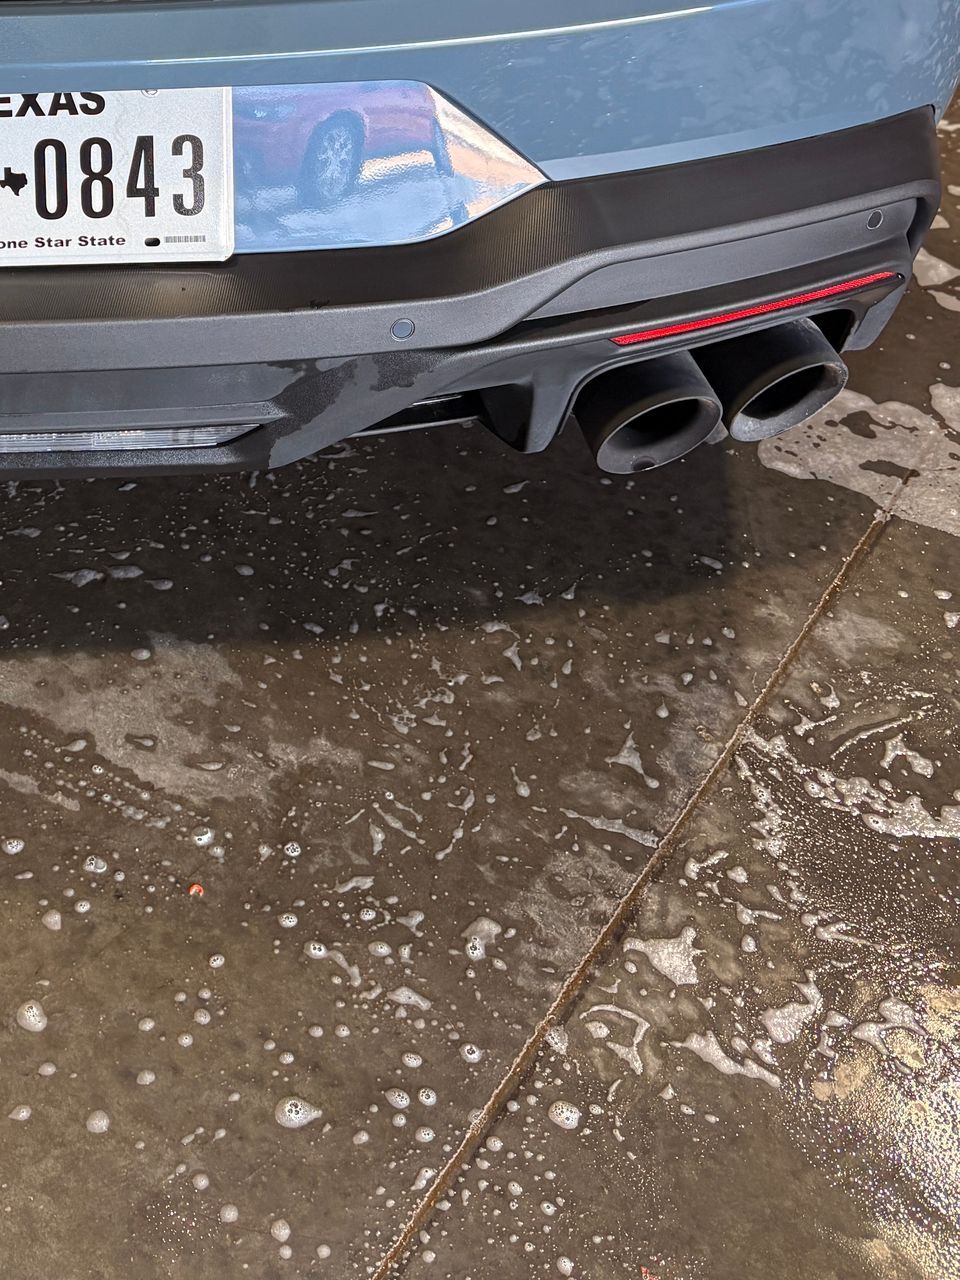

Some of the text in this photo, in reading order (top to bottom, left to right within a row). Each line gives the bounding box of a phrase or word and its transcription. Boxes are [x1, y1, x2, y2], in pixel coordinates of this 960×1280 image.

[34, 133, 205, 220] 0843
[34, 236, 72, 249] Star
[78, 235, 126, 247] State
